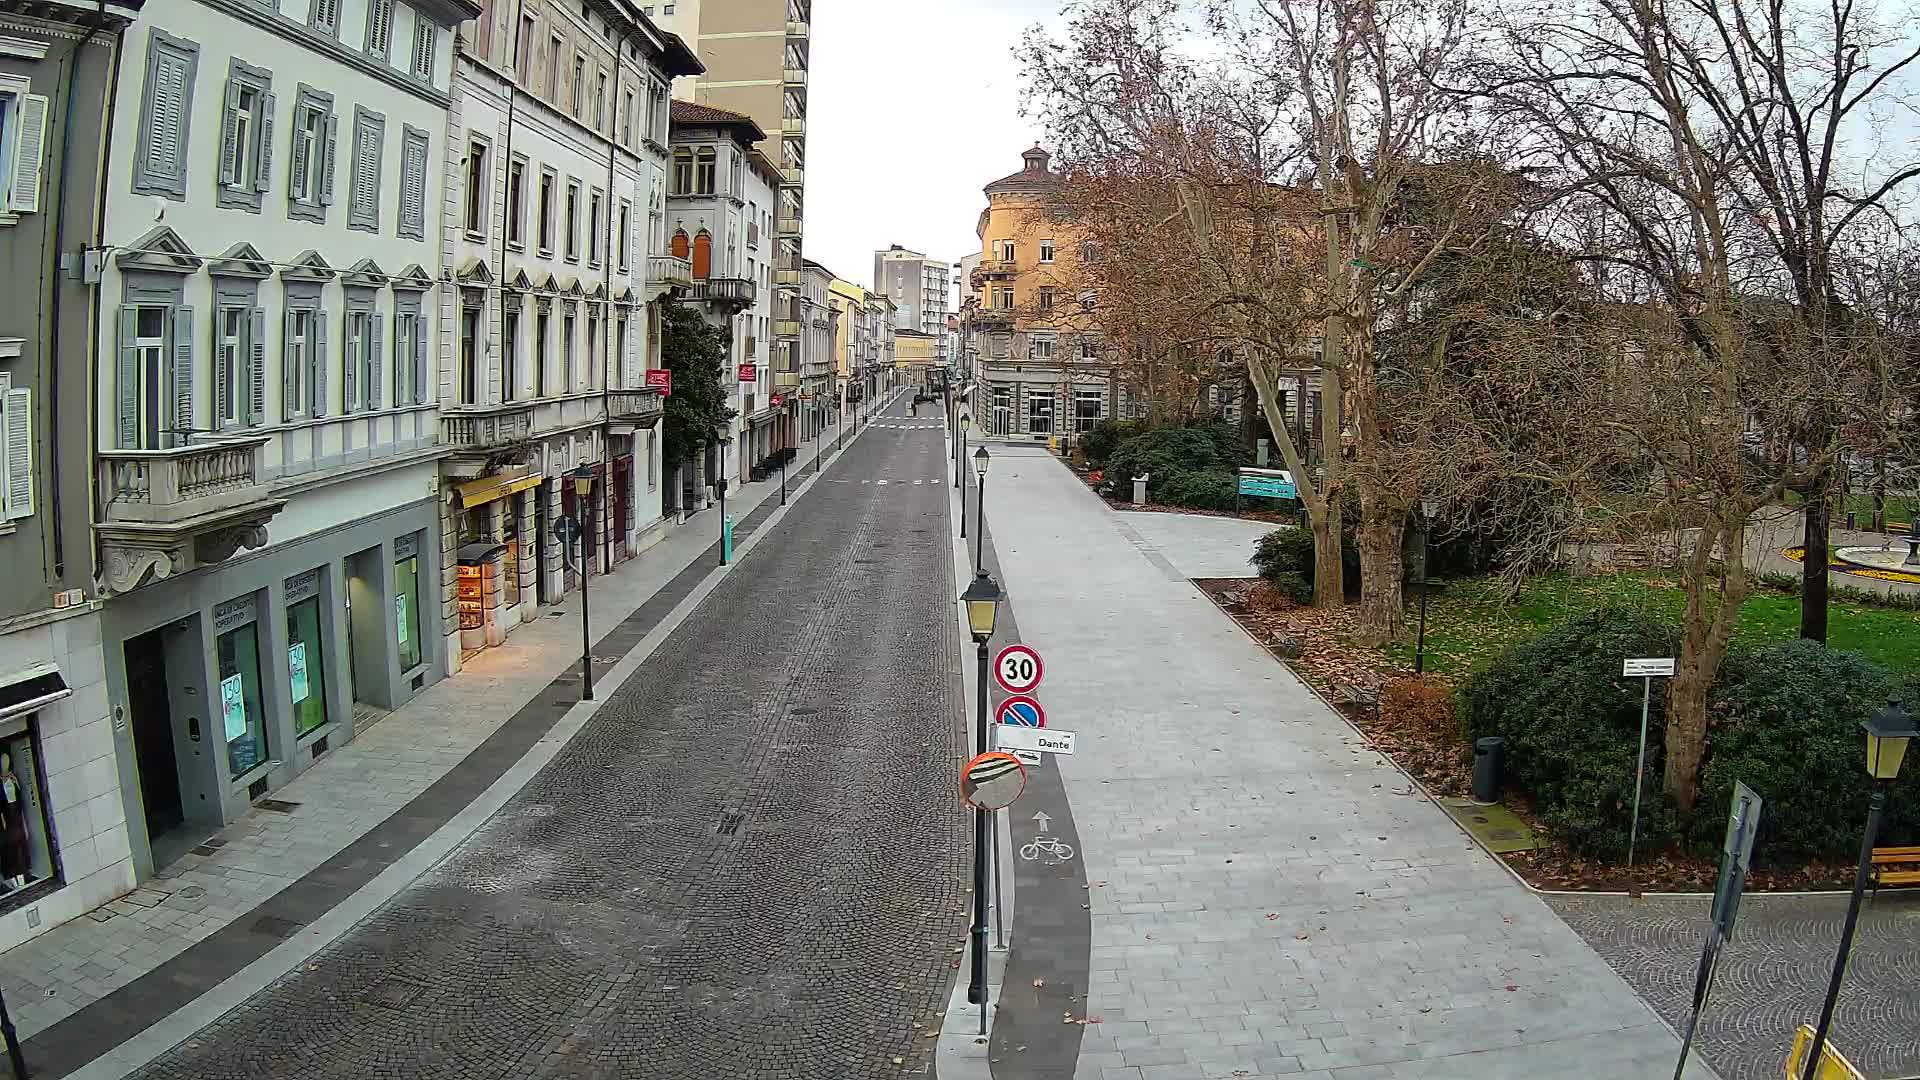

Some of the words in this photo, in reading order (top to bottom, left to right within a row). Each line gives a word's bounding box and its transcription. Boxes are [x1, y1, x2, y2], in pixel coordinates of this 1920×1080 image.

[1006, 658, 1032, 680] 30
[222, 677, 240, 700] 130
[1038, 738, 1070, 750] Dante
